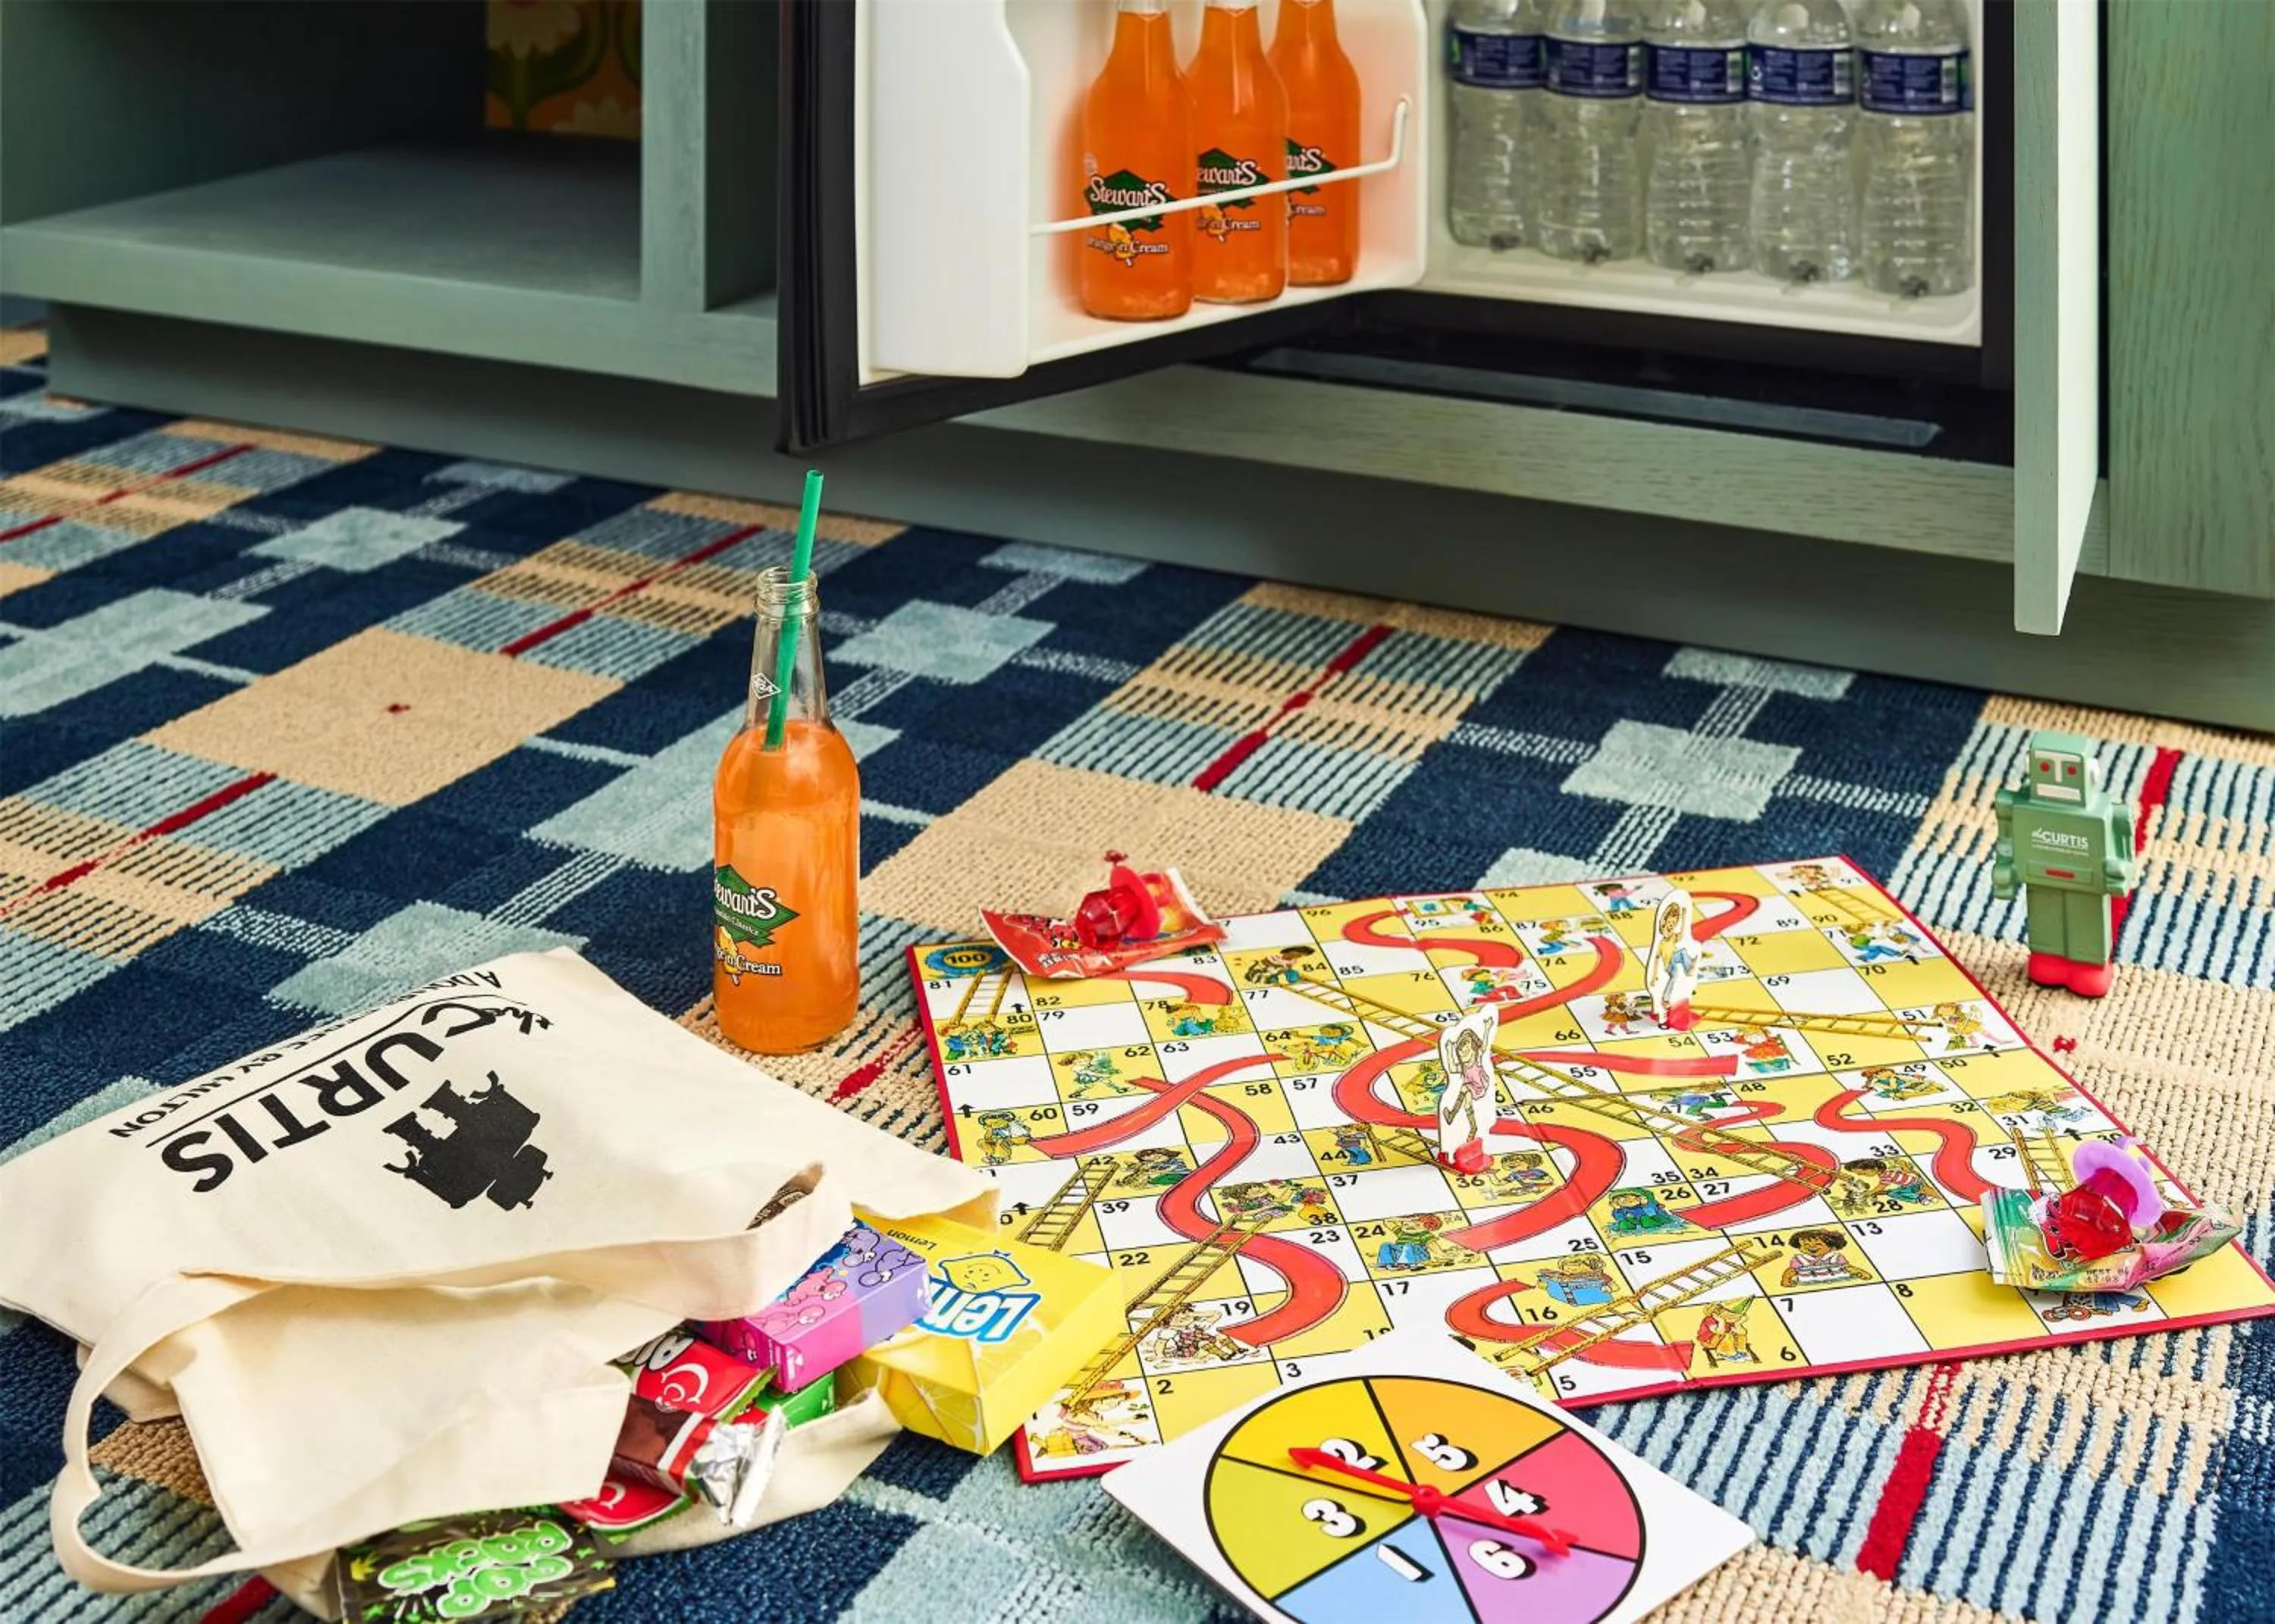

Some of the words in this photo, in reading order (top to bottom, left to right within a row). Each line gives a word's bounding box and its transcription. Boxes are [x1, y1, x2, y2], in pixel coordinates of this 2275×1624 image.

[2042, 830, 2088, 850] CURTIS
[1415, 919, 1441, 927] 95
[1777, 917, 1800, 928] 89
[1812, 914, 1838, 923] 90
[1480, 924, 1504, 933] 86
[1517, 921, 1536, 930] 87
[1825, 928, 1847, 939] 71
[1735, 936, 1762, 946] 72
[736, 955, 781, 975] Cream
[945, 953, 986, 965] 100
[1193, 955, 1217, 964] 83
[1544, 957, 1567, 967] 74
[1302, 962, 1327, 972] 84
[1338, 965, 1365, 975] 85
[1727, 966, 1750, 976] 73
[1862, 965, 1887, 977] 70
[1410, 972, 1436, 982] 76
[1767, 975, 1790, 987] 69
[930, 980, 952, 989] 81
[1520, 980, 1547, 990] 75
[1036, 995, 1062, 1006] 82
[1245, 989, 1269, 999] 77
[1144, 1000, 1168, 1011] 78
[1006, 1014, 1032, 1024] 80
[1040, 1011, 1065, 1020] 79
[1435, 1012, 1461, 1023] 65
[1902, 1009, 1928, 1022] 51
[1265, 1030, 1292, 1042] 64
[1555, 1029, 1581, 1041] 66
[1707, 1033, 1734, 1044] 53
[1163, 1042, 1190, 1053] 63
[1668, 1036, 1696, 1048] 54
[1125, 1046, 1150, 1057] 62
[1827, 1053, 1856, 1067] 52
[1940, 1058, 1968, 1070] 50
[947, 1064, 972, 1075] 61
[1570, 1065, 1597, 1078] 55
[1903, 1064, 1927, 1074] 49
[1244, 1083, 1272, 1096] 58
[1293, 1078, 1318, 1090] 57
[1740, 1083, 1767, 1093] 48
[161, 1002, 497, 1193] CURTIS
[1495, 1089, 1505, 1103] 6
[1029, 1108, 1058, 1121] 60
[1072, 1103, 1099, 1117] 59
[1527, 1103, 1555, 1114] 46
[1659, 1103, 1682, 1115] 47
[1950, 1102, 1980, 1114] 32
[2002, 1115, 2030, 1127] 31
[1273, 1133, 1301, 1145] 43
[1320, 1149, 1348, 1162] 44
[1869, 1144, 1900, 1158] 33
[1988, 1147, 2016, 1161] 29
[1089, 1156, 1115, 1166] 42
[1651, 1171, 1681, 1184] 35
[1690, 1166, 1719, 1180] 34
[1332, 1174, 1358, 1187] 37
[1455, 1175, 1485, 1188] 36
[1660, 1187, 1691, 1201] 26
[1703, 1182, 1731, 1196] 27
[1102, 1201, 1130, 1215] 39
[1872, 1199, 1904, 1214] 28
[1000, 1214, 1013, 1225] 0
[1309, 1212, 1338, 1226] 38
[1354, 1224, 1386, 1239] 24
[1850, 1221, 1884, 1237] 13
[886, 1228, 938, 1251] Lemon
[1310, 1230, 1341, 1244] 23
[1753, 1234, 1786, 1249] 14
[1567, 1237, 1599, 1252] 25
[1119, 1252, 1150, 1267] 22
[1620, 1251, 1652, 1265] 15
[1381, 1281, 1410, 1296] 17
[1895, 1283, 1915, 1298] 8
[1219, 1301, 1250, 1316] 19
[1779, 1297, 1794, 1312] 7
[1525, 1306, 1558, 1321] 16
[1780, 1346, 1796, 1362] 6
[1285, 1362, 1302, 1378] 3
[1156, 1379, 1175, 1395] 2
[1558, 1375, 1577, 1391] 5
[1410, 1432, 1476, 1471] 5
[1483, 1478, 1547, 1516] 4
[1301, 1498, 1364, 1538] 3
[1376, 1542, 1432, 1582] 1
[1468, 1539, 1534, 1579] 6
